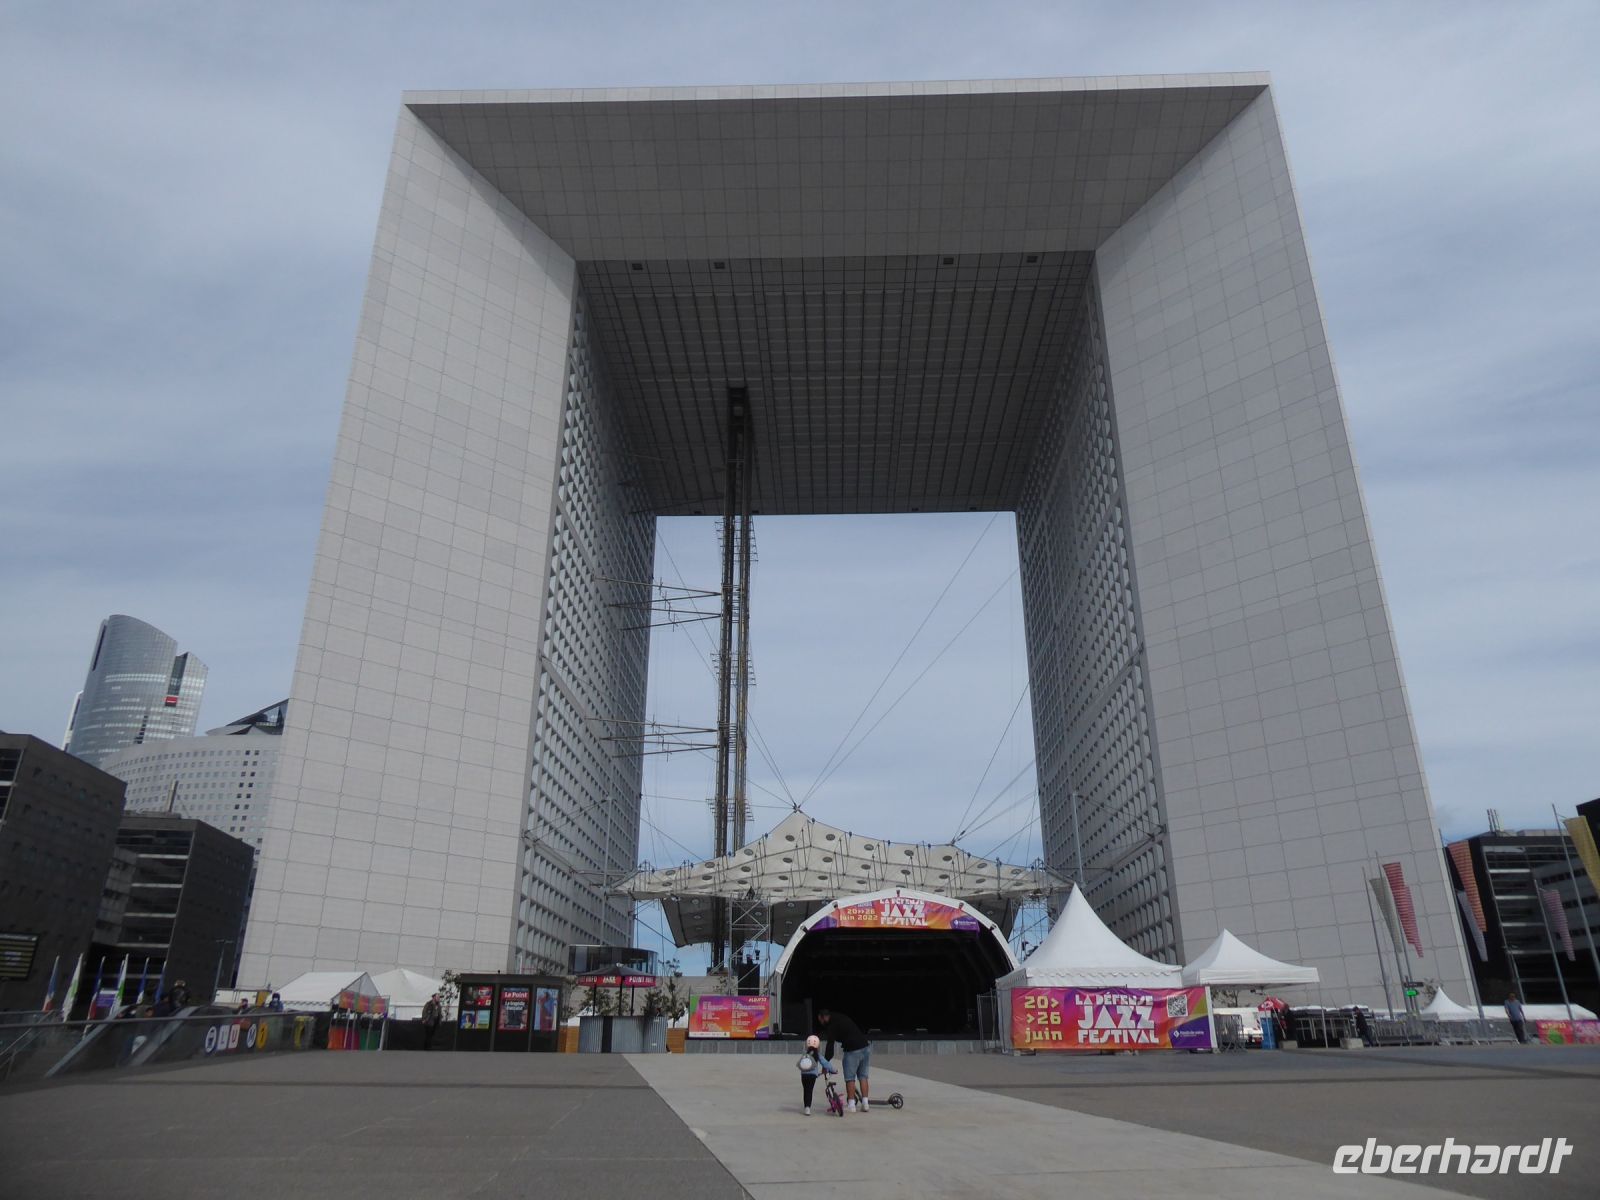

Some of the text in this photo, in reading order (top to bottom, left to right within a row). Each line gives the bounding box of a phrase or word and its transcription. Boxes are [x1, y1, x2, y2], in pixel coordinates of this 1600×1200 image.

[880, 903, 926, 917] JAZZ
[880, 916, 928, 926] FESTIVAL
[1075, 992, 1153, 1006] LA DÉFENSE
[1077, 1005, 1155, 1029] JAZZ
[1024, 1027, 1062, 1043] juin
[1077, 1029, 1160, 1044] FESTIVAL
